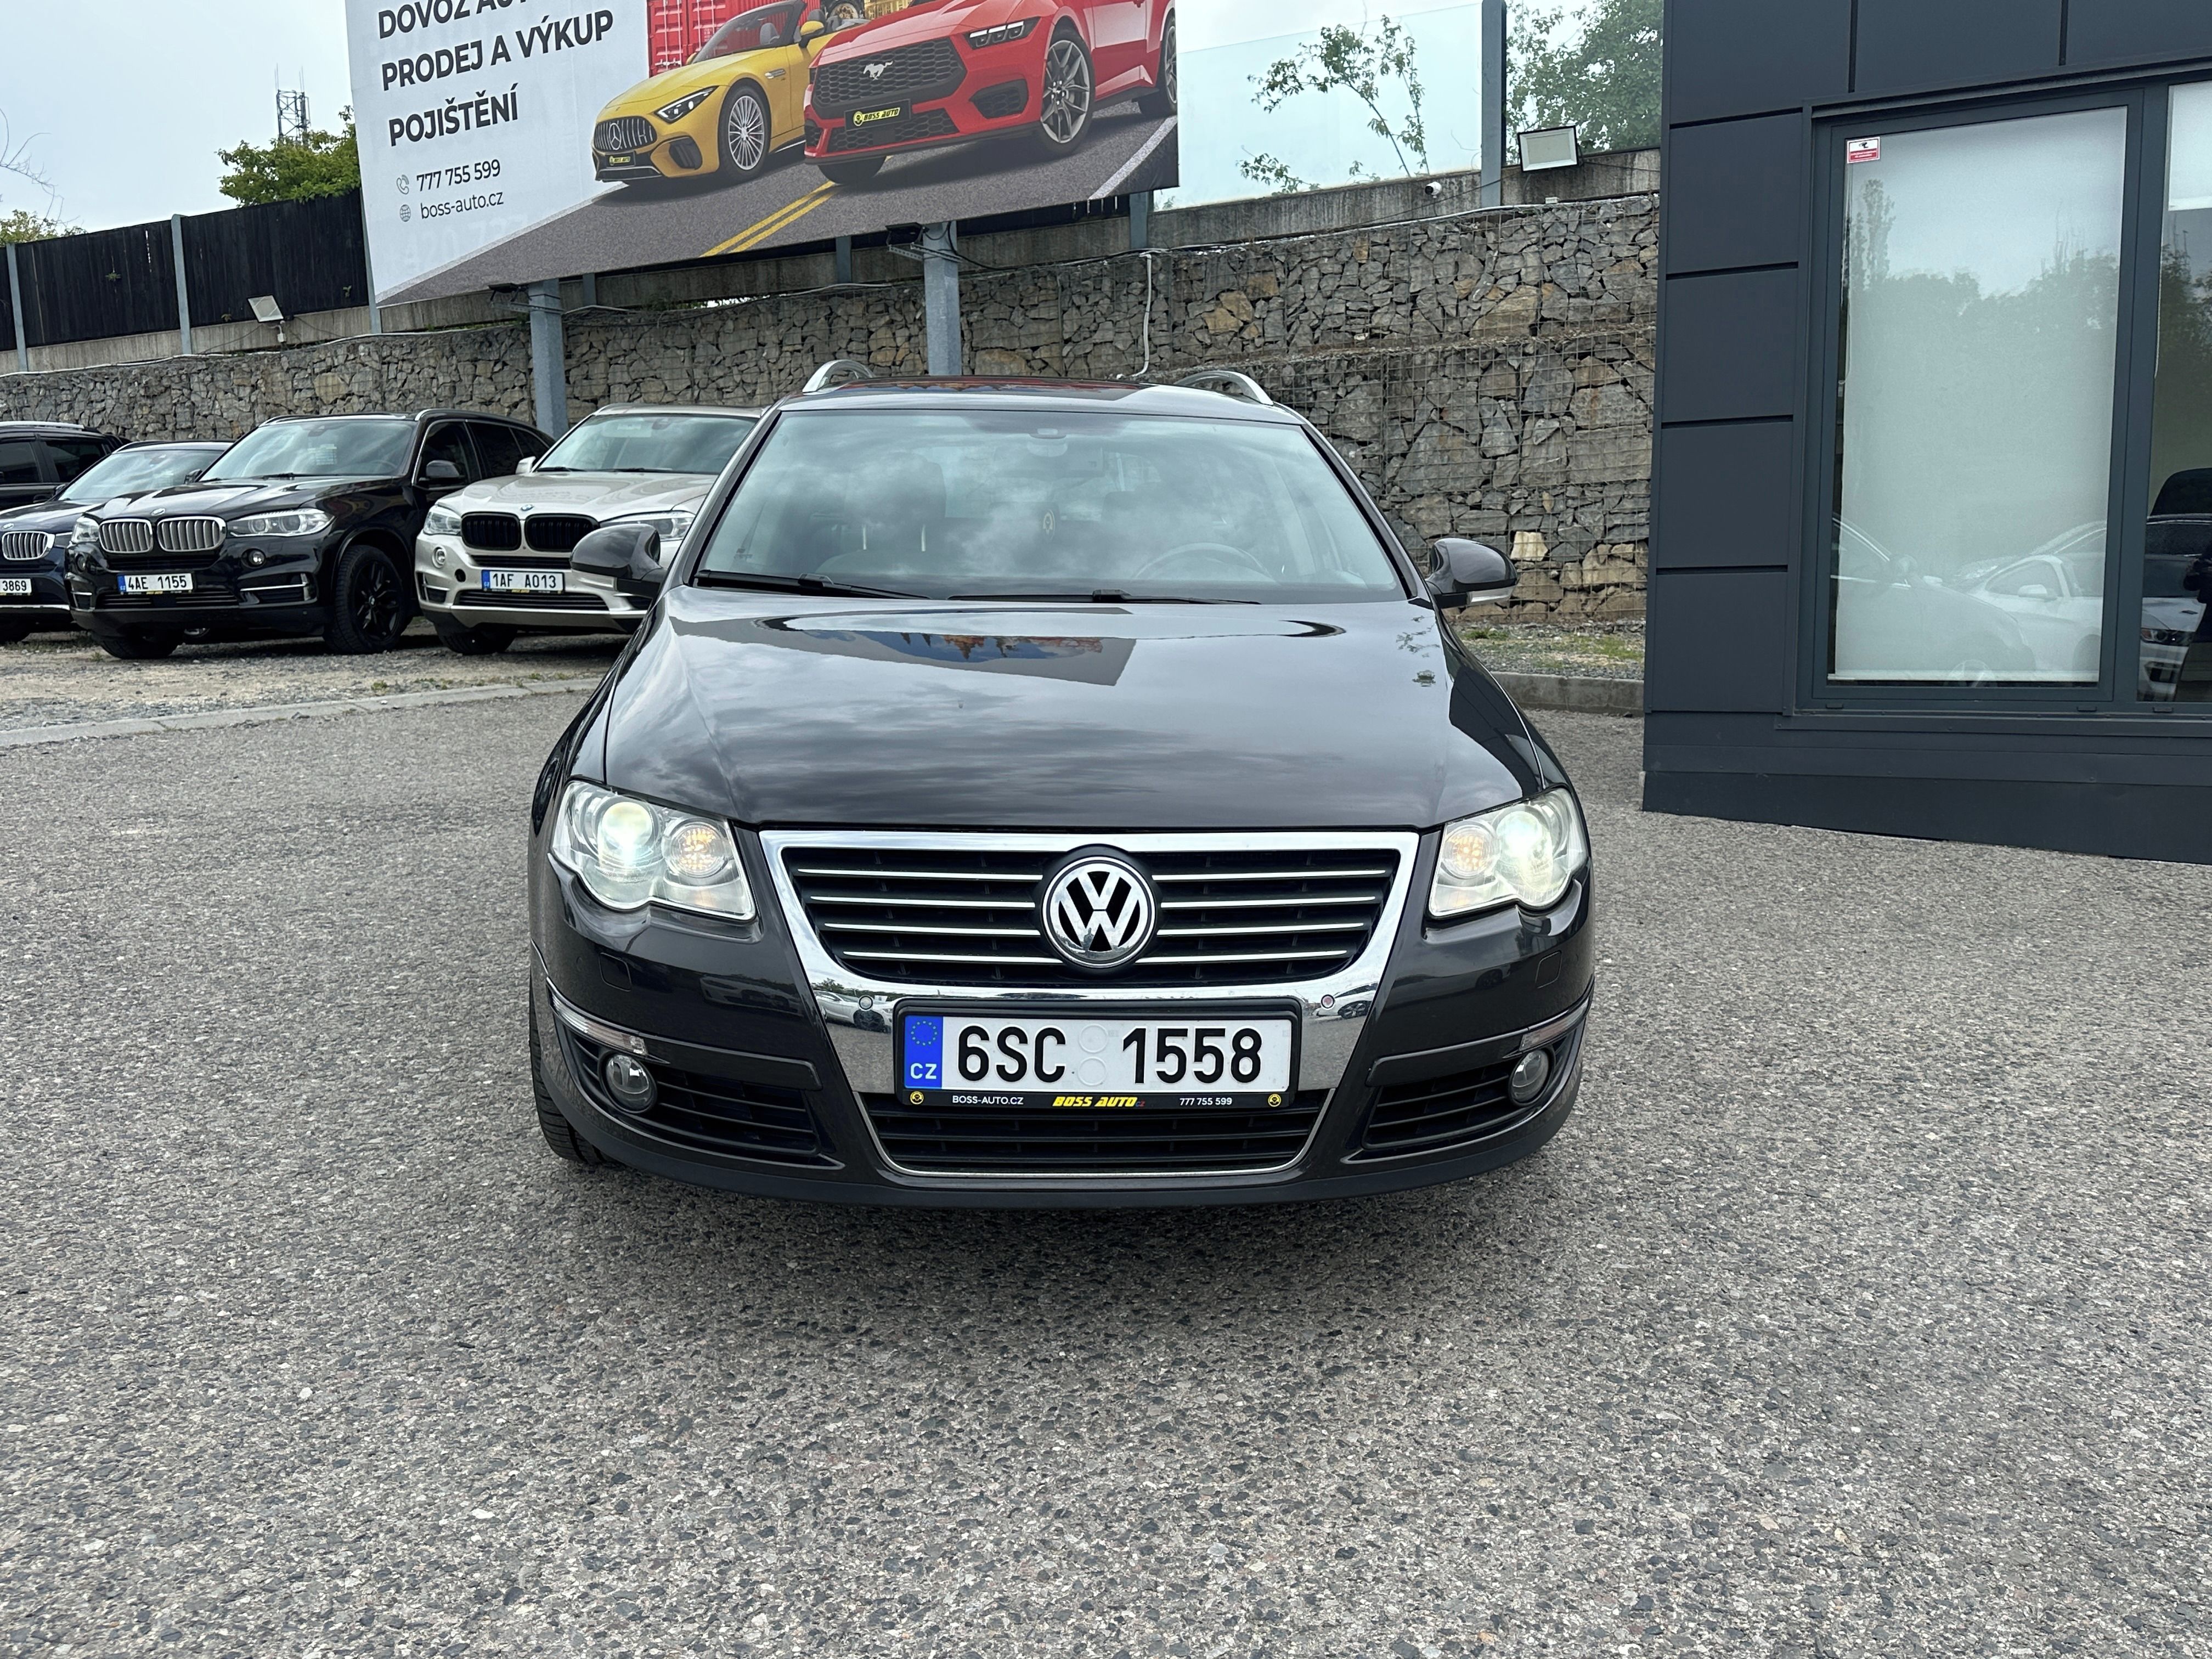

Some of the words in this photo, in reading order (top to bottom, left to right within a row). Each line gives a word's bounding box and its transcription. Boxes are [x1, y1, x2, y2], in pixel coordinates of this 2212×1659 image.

[379, 0, 470, 39] DOVOZ
[382, 40, 483, 91] PRODEJ
[490, 35, 511, 66] A
[515, 9, 613, 58] VÝKUP
[388, 83, 518, 146] POJIŠTĚNÍ
[864, 112, 880, 121] BOSS
[416, 171, 441, 191] 777
[445, 165, 470, 185] 755
[475, 159, 500, 180] 599
[420, 192, 504, 219] boss-auto.cz
[2, 580, 27, 591] 3869
[128, 576, 149, 590] 4AE
[157, 575, 187, 589] 1155
[493, 573, 514, 587] 1AF
[957, 1025, 1066, 1083] 6SC
[1122, 1028, 1261, 1084] 1558
[910, 1063, 937, 1080] CZ
[952, 1095, 1024, 1105] BOSS-AUTO.CZ
[1052, 1096, 1093, 1107] BOSS
[1094, 1097, 1138, 1107] AUTO
